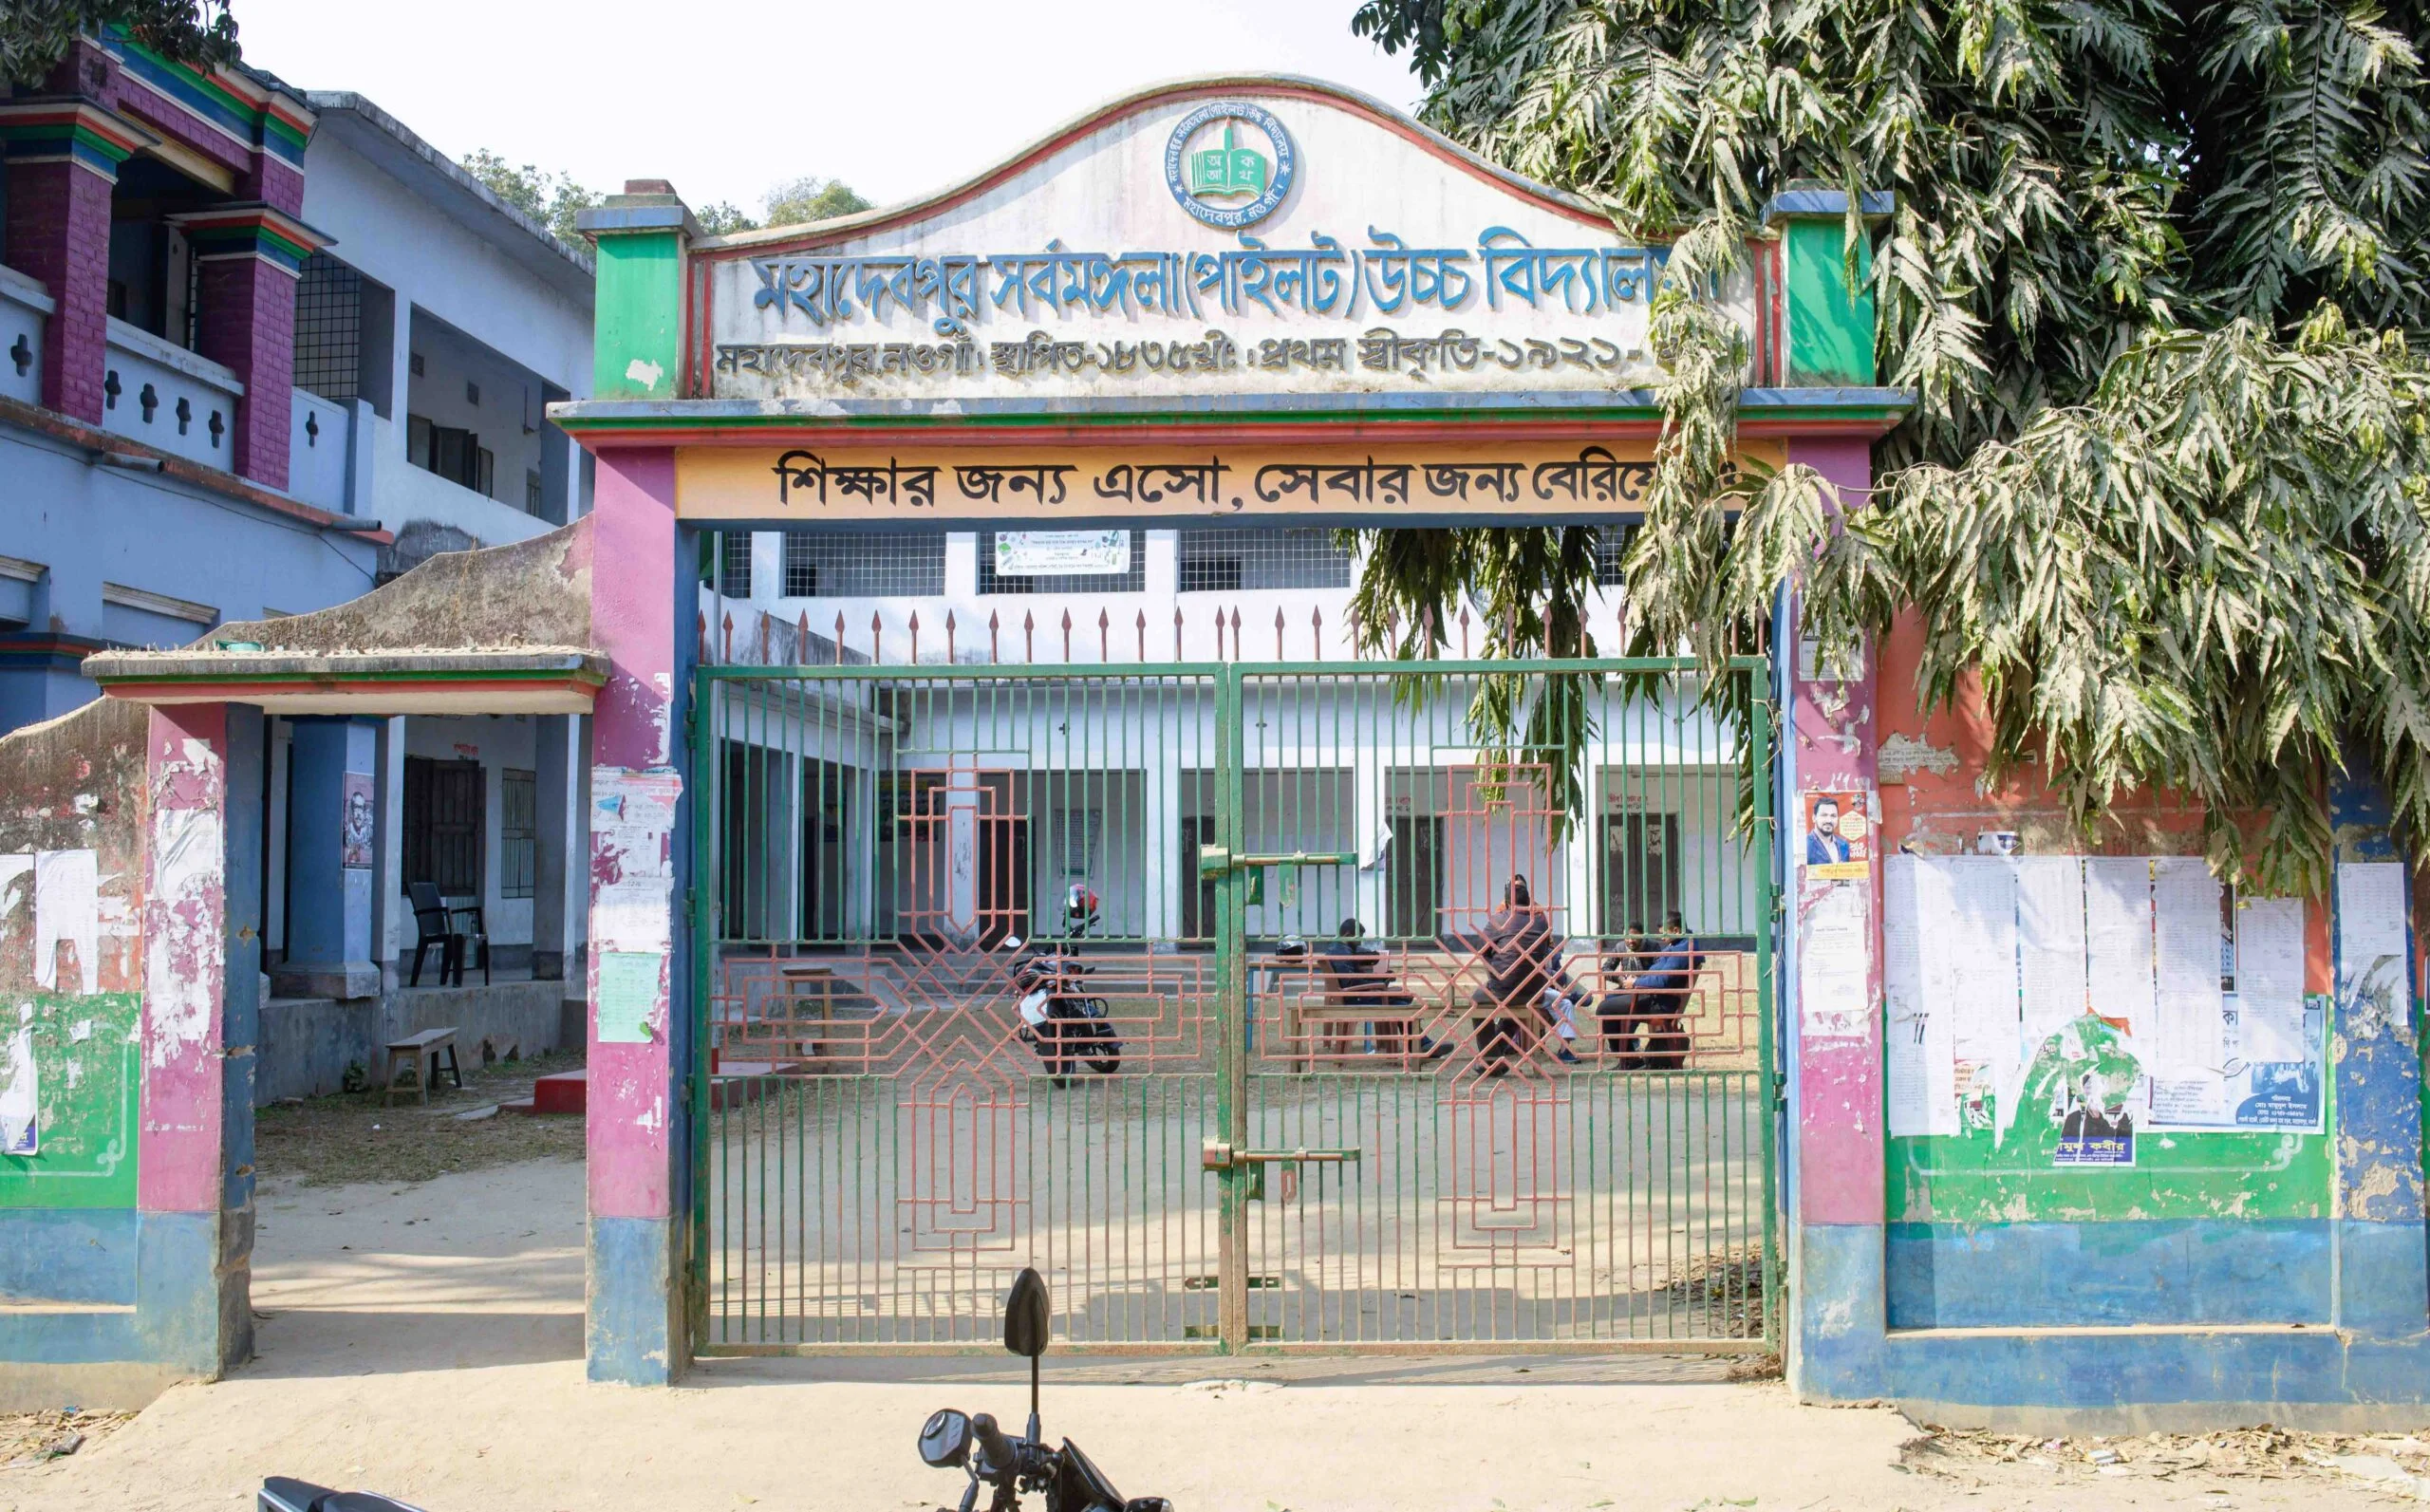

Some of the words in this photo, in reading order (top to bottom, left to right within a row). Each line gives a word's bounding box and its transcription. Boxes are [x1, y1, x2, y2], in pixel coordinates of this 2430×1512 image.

[754, 254, 978, 335] মহাদেবপুর
[775, 451, 941, 507] শিক্ষার
[954, 463, 1077, 506] জন্য
[1094, 456, 1245, 513] এসো,
[1254, 456, 1418, 506] সেবার
[1425, 463, 1524, 505] জন্য
